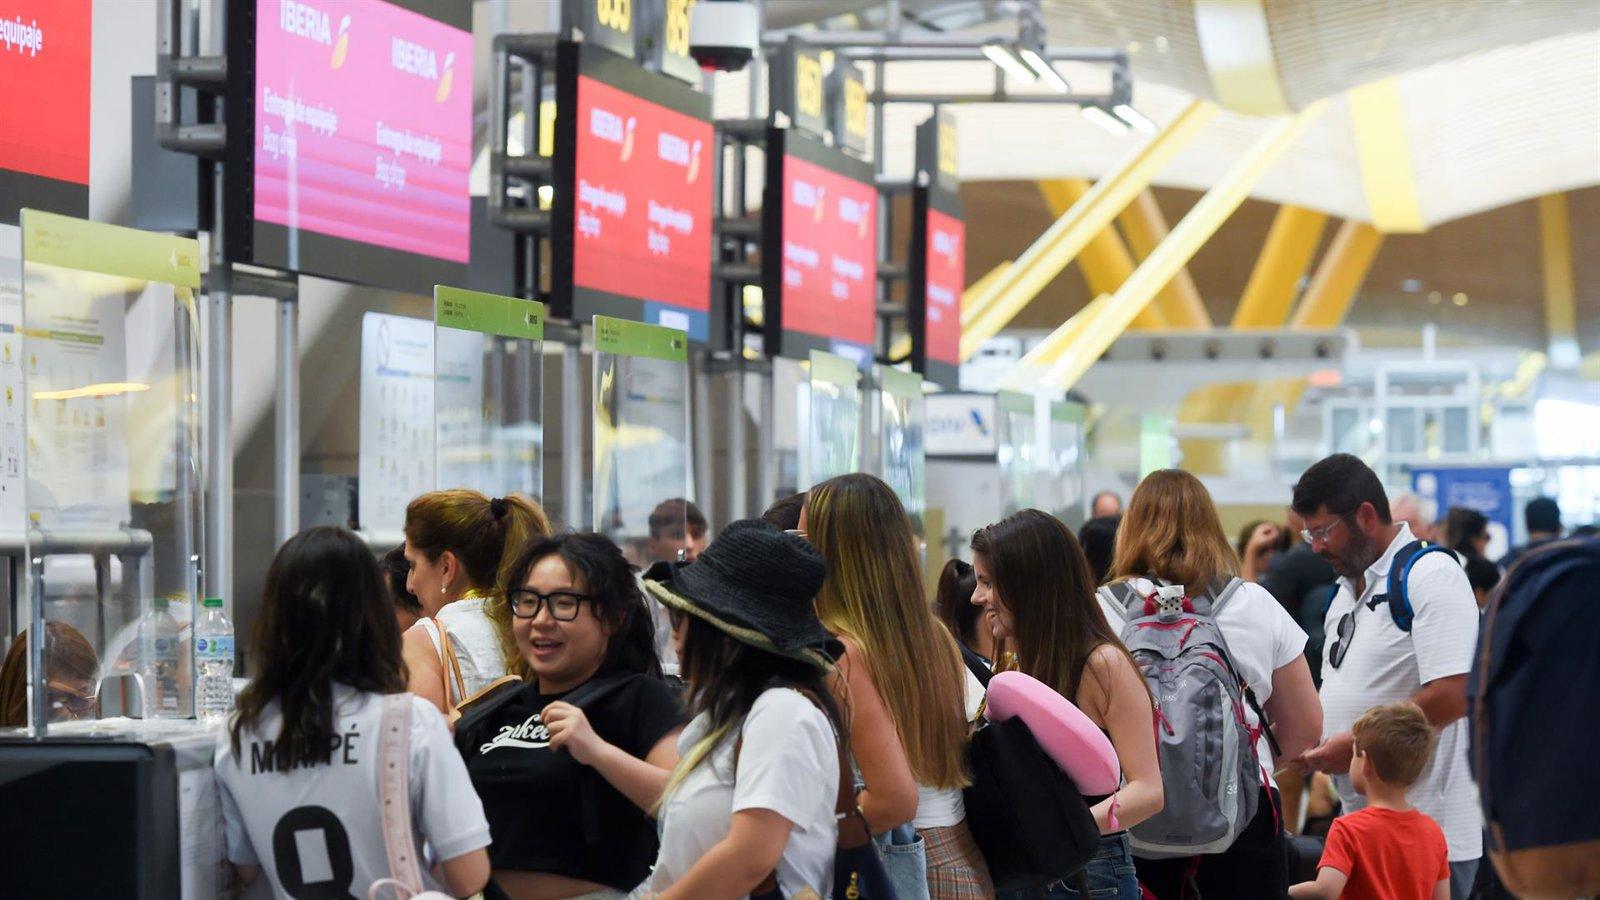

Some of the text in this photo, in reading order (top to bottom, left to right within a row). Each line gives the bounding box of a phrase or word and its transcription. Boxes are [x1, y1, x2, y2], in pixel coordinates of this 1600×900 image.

[0, 14, 43, 57] equipaje
[280, 0, 332, 46] IBERIA
[391, 36, 439, 81] IBERIA
